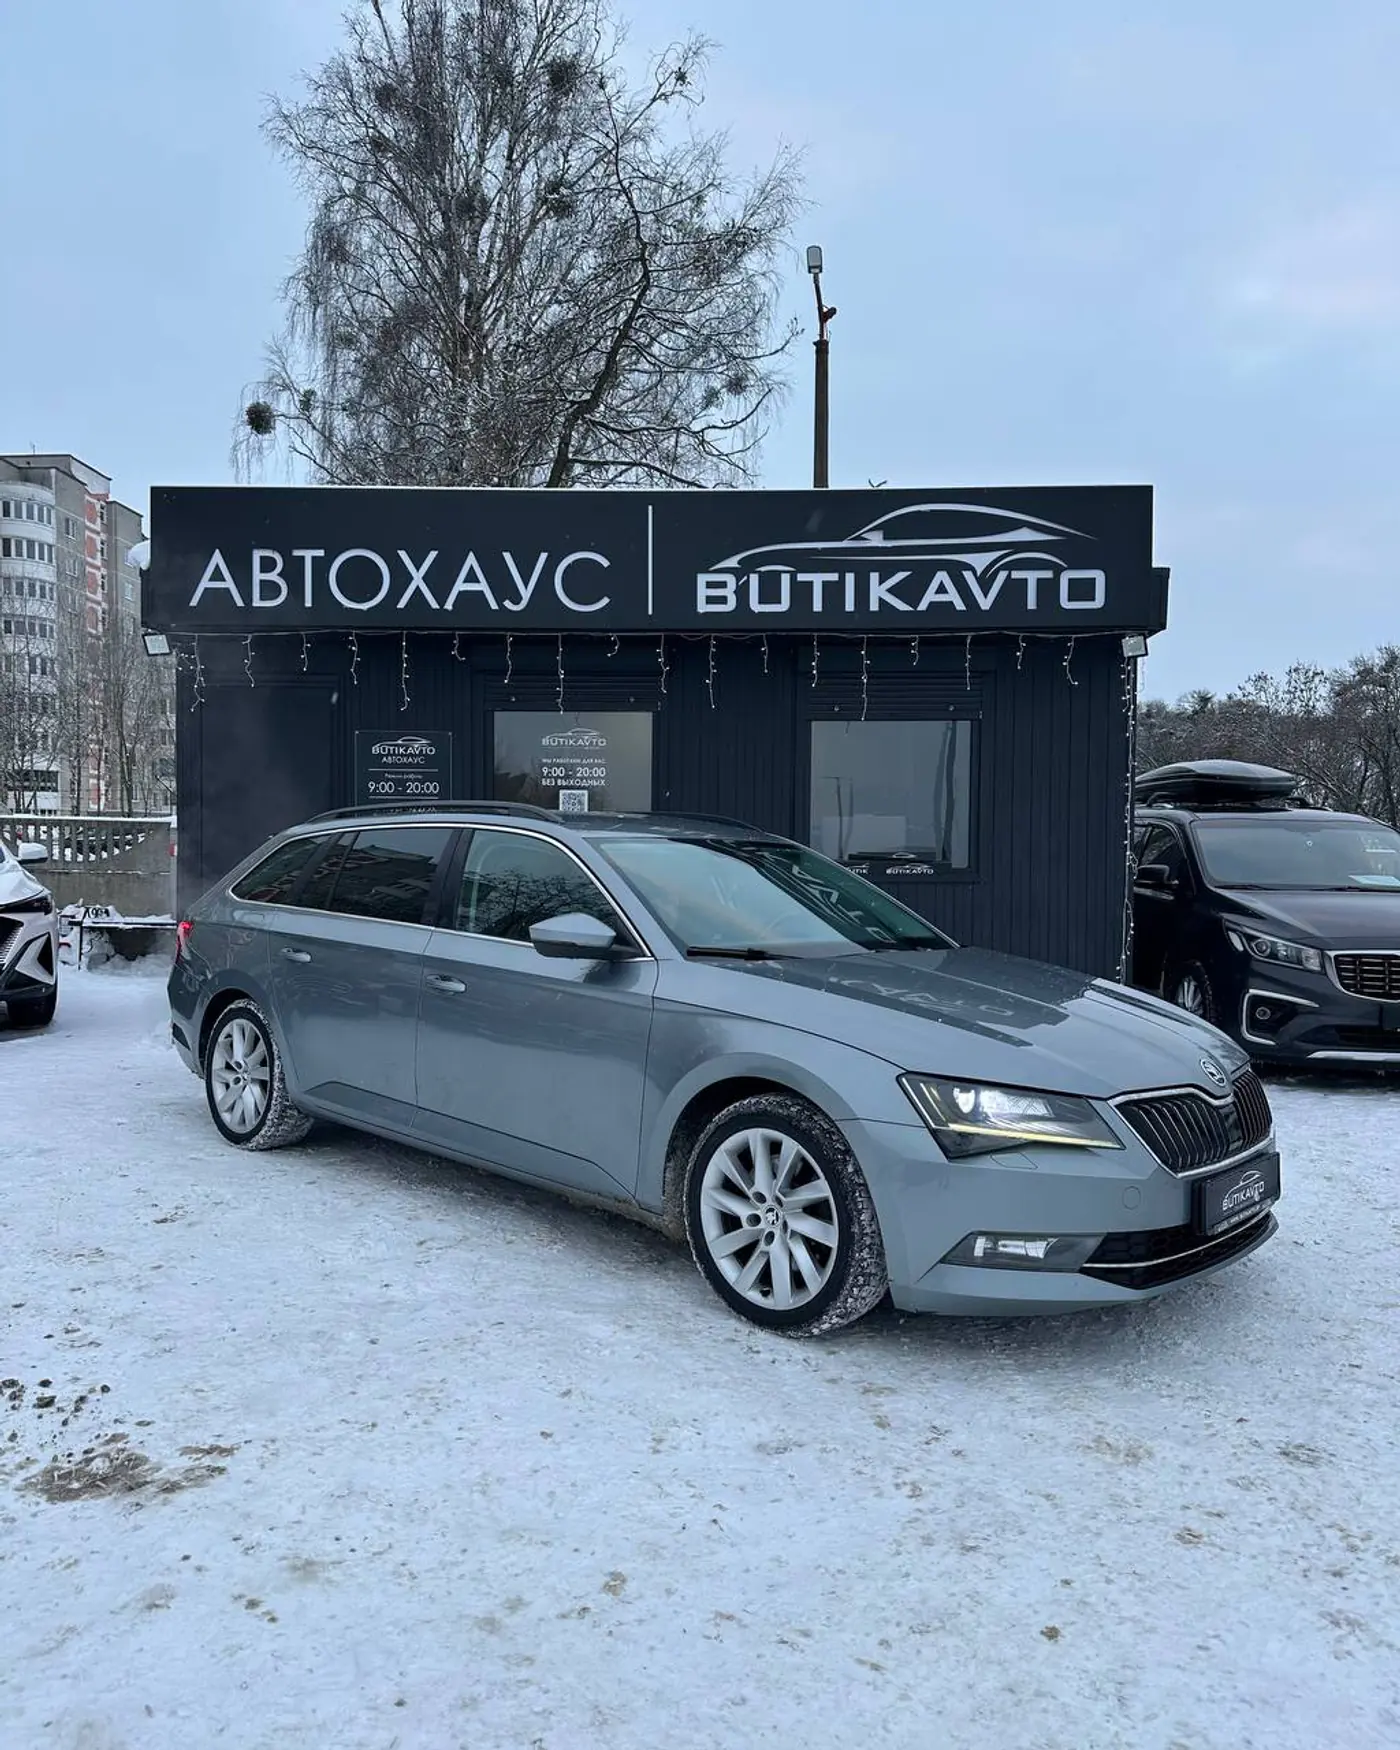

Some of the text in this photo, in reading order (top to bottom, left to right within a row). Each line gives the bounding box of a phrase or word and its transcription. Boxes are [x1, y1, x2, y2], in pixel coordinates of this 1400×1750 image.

[189, 548, 611, 613] АВТОХАУС
[696, 568, 1106, 614] BUTIKAVTO
[542, 737, 607, 746] BUTIKAVTO
[371, 745, 436, 755] BUTIKAVTO
[381, 756, 426, 764] АВТОХАУС
[541, 766, 565, 778] 9:00
[576, 766, 606, 778] 20:00
[367, 780, 395, 794] 9:00
[405, 781, 440, 794] 20:00
[541, 778, 606, 787] БЕЗ ВЫХОДНЫХ
[1222, 1181, 1265, 1211] BUTIKAVTO
